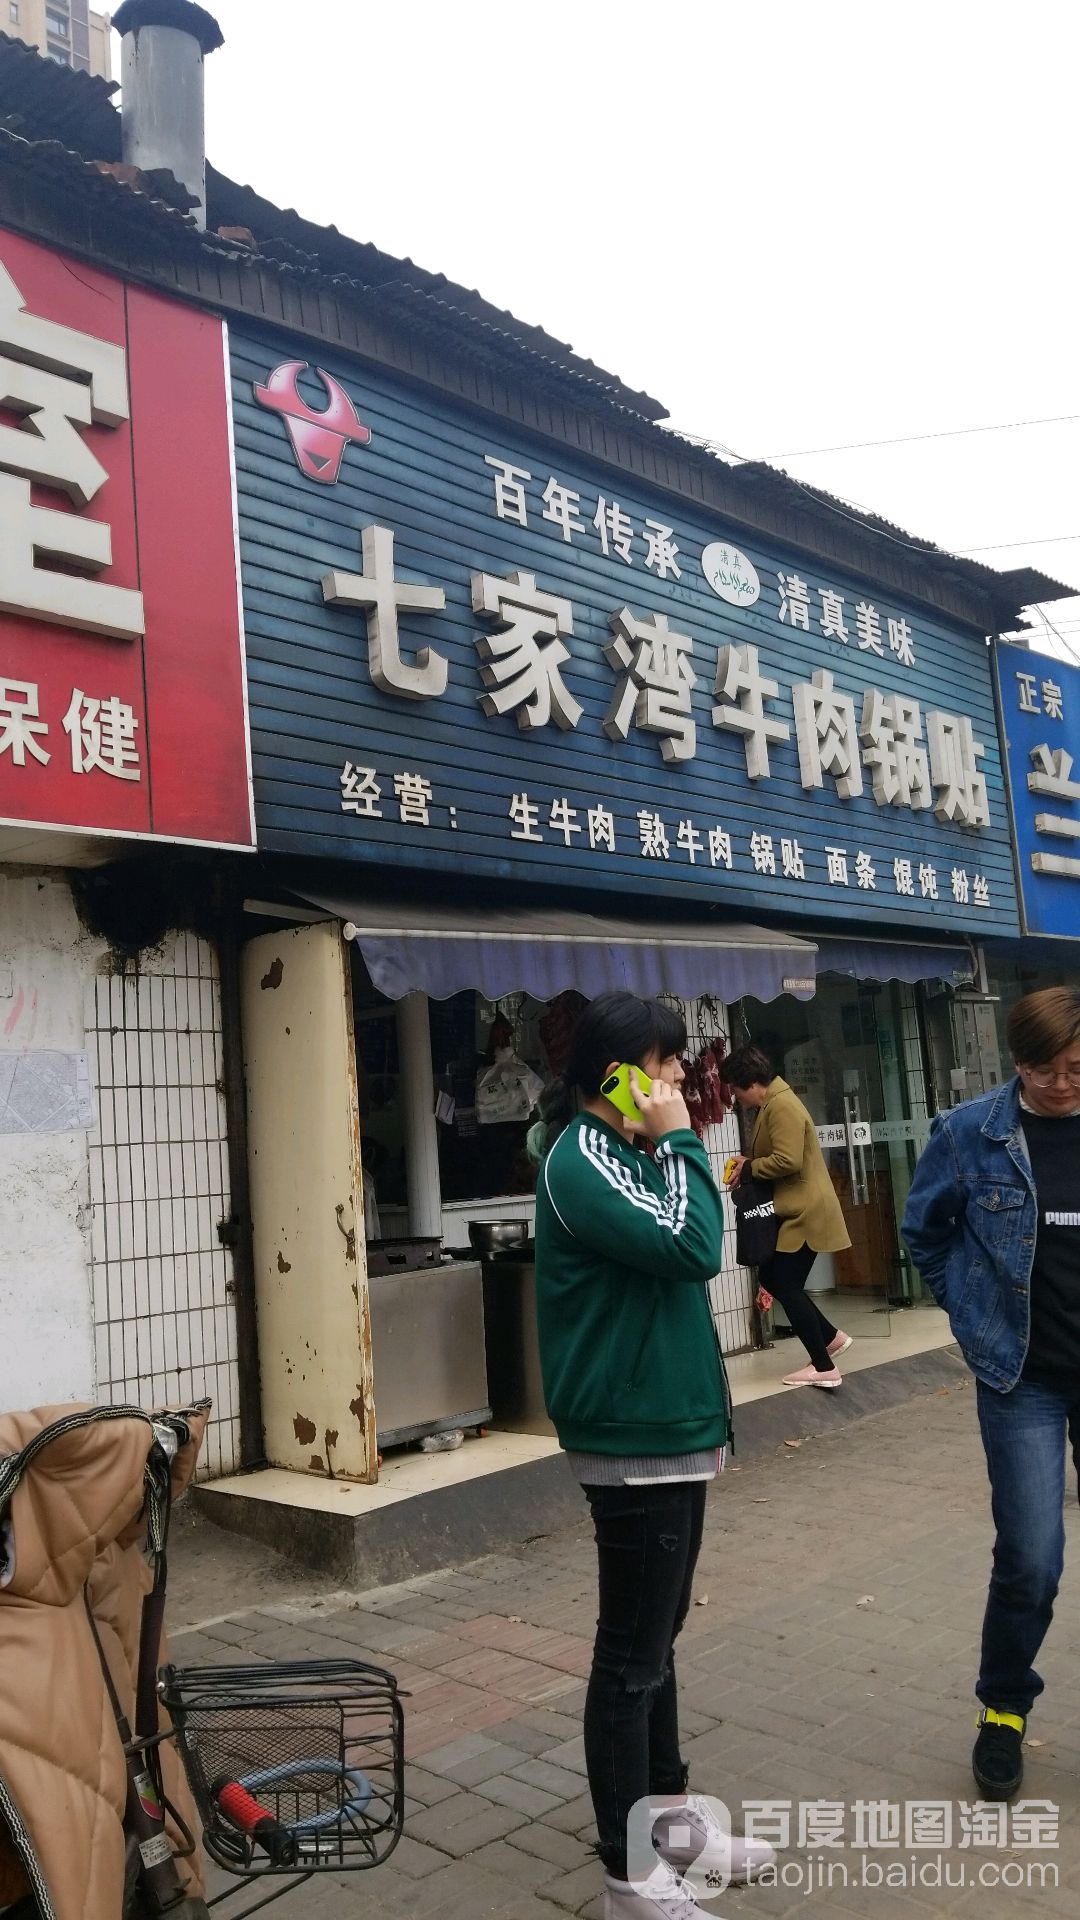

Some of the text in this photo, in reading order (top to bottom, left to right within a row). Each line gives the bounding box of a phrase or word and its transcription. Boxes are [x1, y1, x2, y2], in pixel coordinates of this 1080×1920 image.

[484, 454, 682, 580] 百年传承
[776, 569, 917, 667] 清真美味
[321, 524, 991, 830] 七家湾牛肉锅贴
[1016, 671, 1064, 721] 正宗
[509, 793, 615, 853] 生牛肉
[637, 810, 733, 870] 熟牛肉
[750, 831, 805, 880] 锅贴
[824, 846, 876, 890] 面条
[893, 857, 938, 900] 馄饨
[951, 867, 990, 907] 粉丝
[1045, 1211, 1080, 1226] PUM
